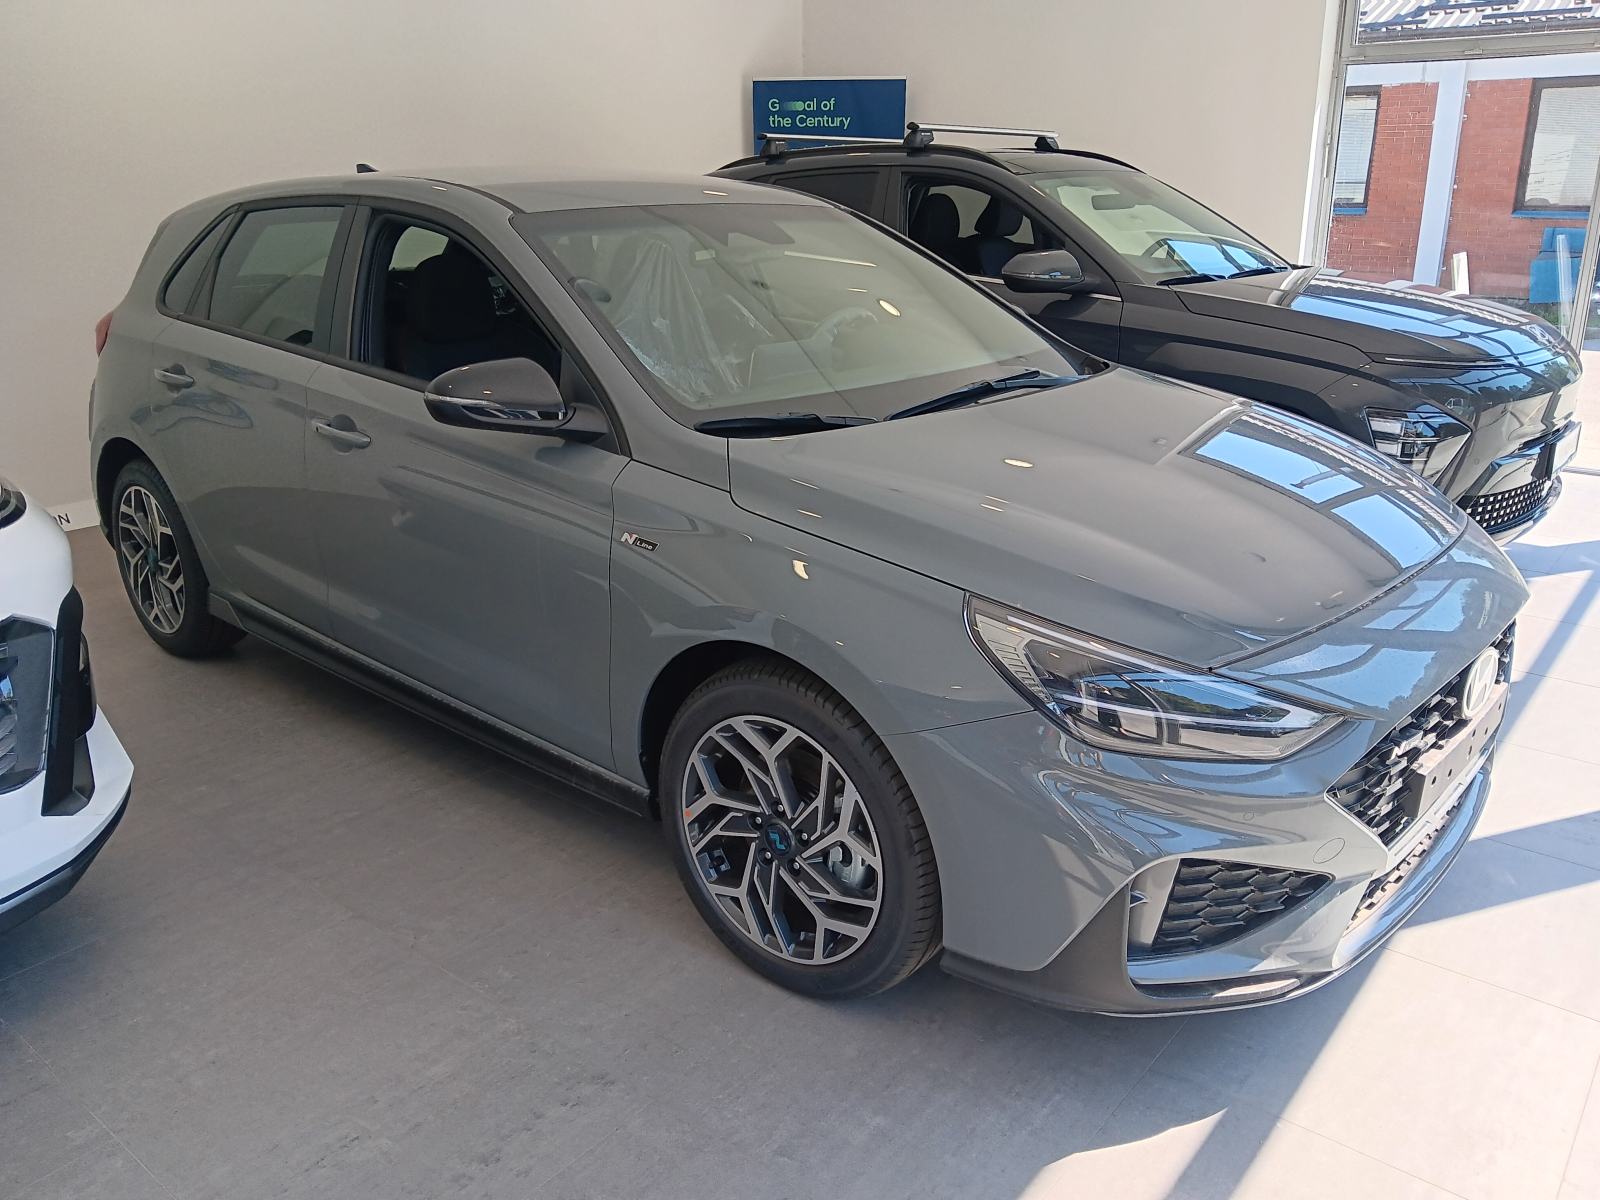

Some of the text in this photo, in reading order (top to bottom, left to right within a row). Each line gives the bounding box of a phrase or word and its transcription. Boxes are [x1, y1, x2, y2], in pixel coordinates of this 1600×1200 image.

[820, 97, 836, 111] of
[768, 114, 851, 130] the Century
[620, 532, 653, 550] N Line
